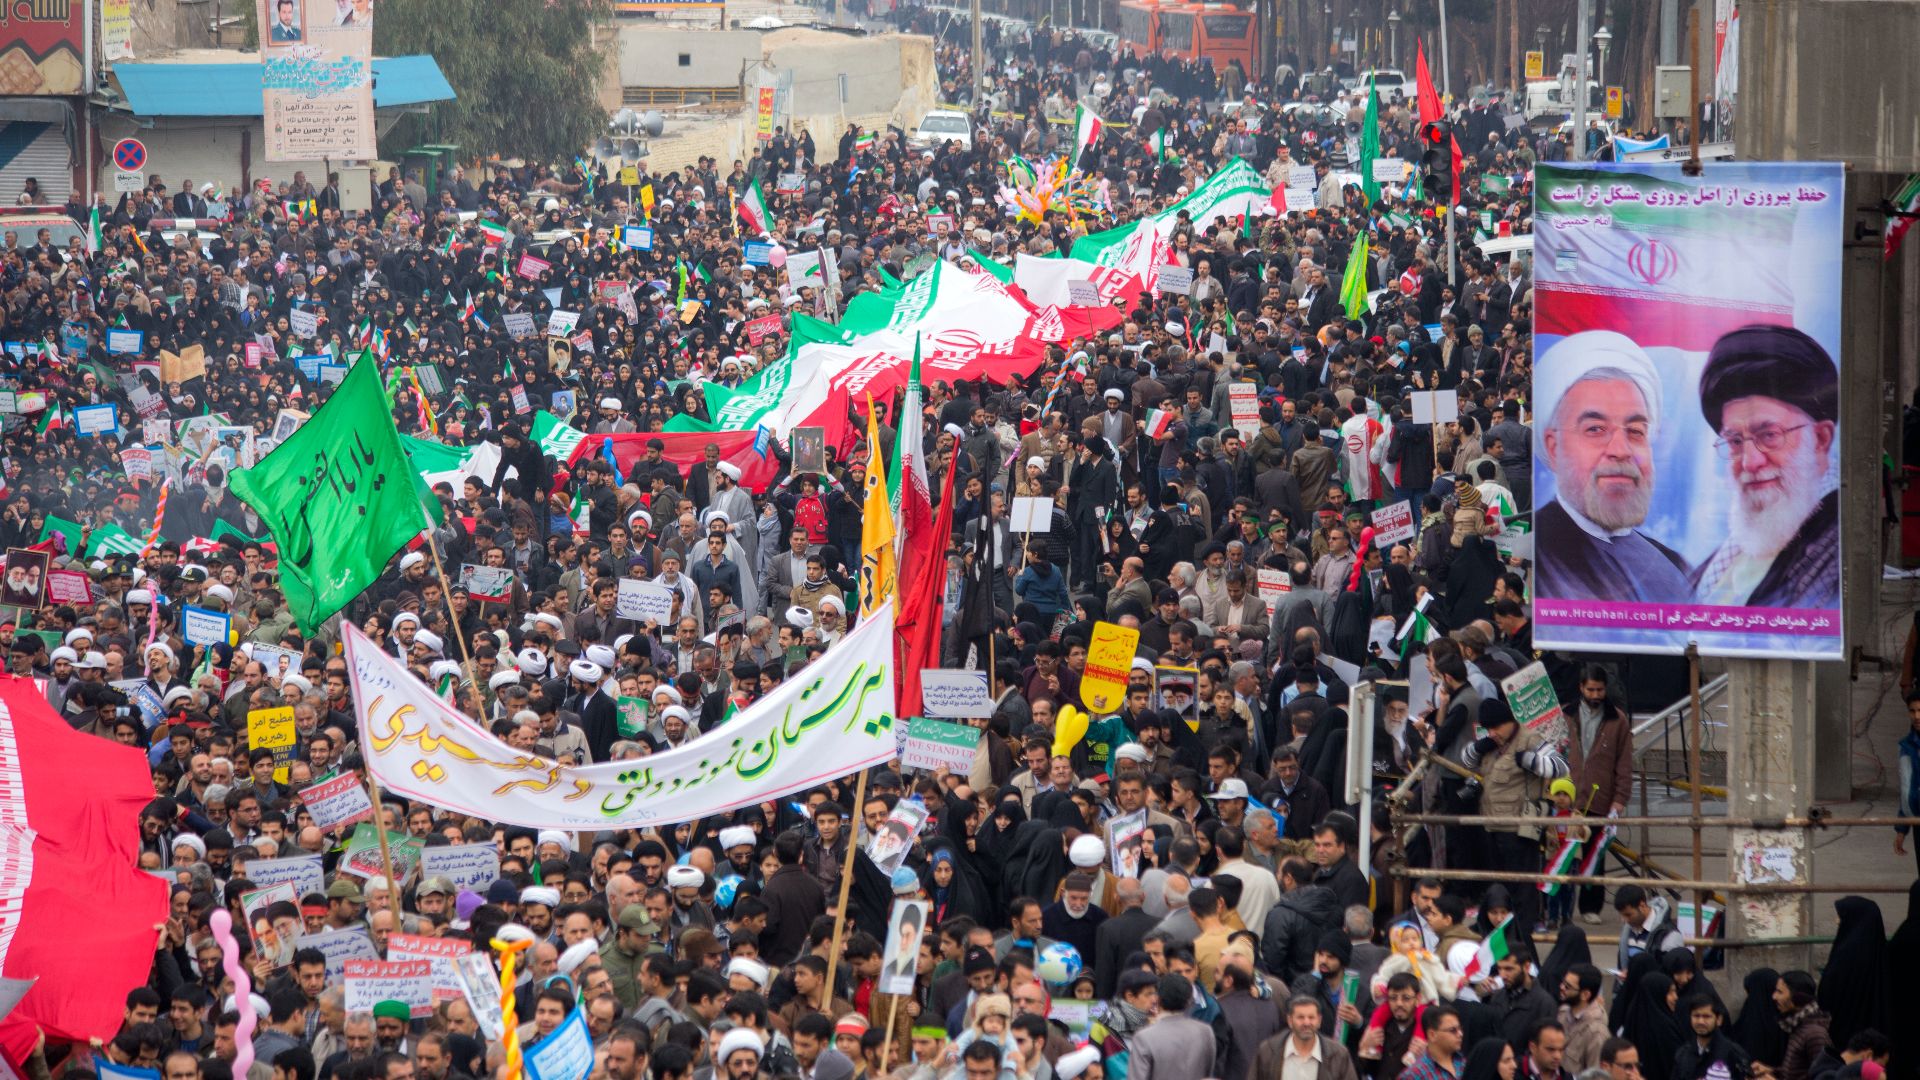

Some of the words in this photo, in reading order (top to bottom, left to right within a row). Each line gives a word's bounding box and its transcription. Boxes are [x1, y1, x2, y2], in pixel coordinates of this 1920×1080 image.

[1552, 187, 1582, 201] است
[1584, 187, 1600, 206] تر
[1603, 186, 1641, 204] مشکل
[1693, 187, 1721, 205] اصل
[1726, 187, 1739, 206] از
[1743, 189, 1792, 207] پیروزی
[1796, 186, 1827, 202] حفظ
[1594, 215, 1612, 231] امام
[1540, 607, 1657, 623] www.Hrouhani.com
[1710, 612, 1744, 627] روحانی
[1745, 613, 1766, 628] دکتر
[1768, 615, 1808, 630] همراهان
[1810, 618, 1831, 631] دفتر
[1088, 663, 1099, 671] WE
[1099, 665, 1119, 676] STAND
[272, 745, 293, 754] ERELY
[908, 739, 924, 750] WE
[926, 743, 960, 756] STAND
[961, 748, 976, 760] UP
[908, 752, 922, 763] TO
